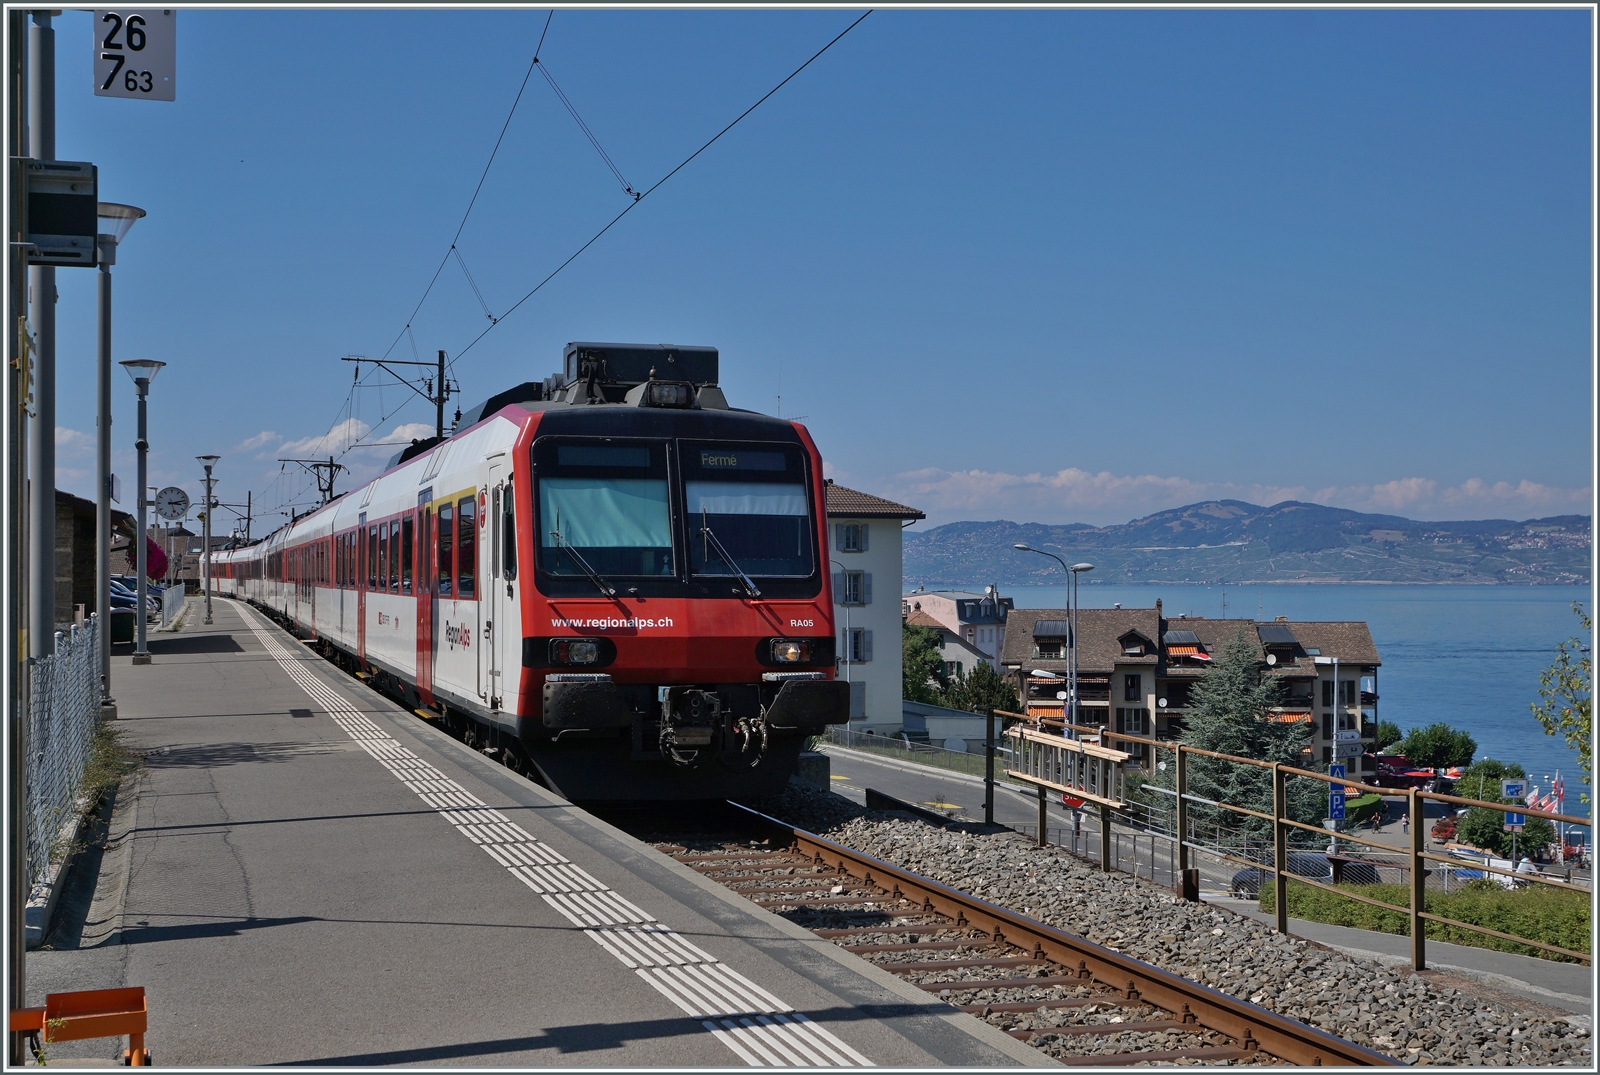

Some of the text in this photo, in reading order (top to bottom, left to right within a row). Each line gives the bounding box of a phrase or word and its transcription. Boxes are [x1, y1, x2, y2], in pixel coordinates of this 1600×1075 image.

[102, 13, 146, 51] 26
[701, 453, 737, 466] Fermé
[551, 616, 674, 630] www.regionalps.ch
[790, 619, 814, 627] RA05
[445, 620, 470, 651] RegionAlps
[1333, 795, 1341, 809] P
